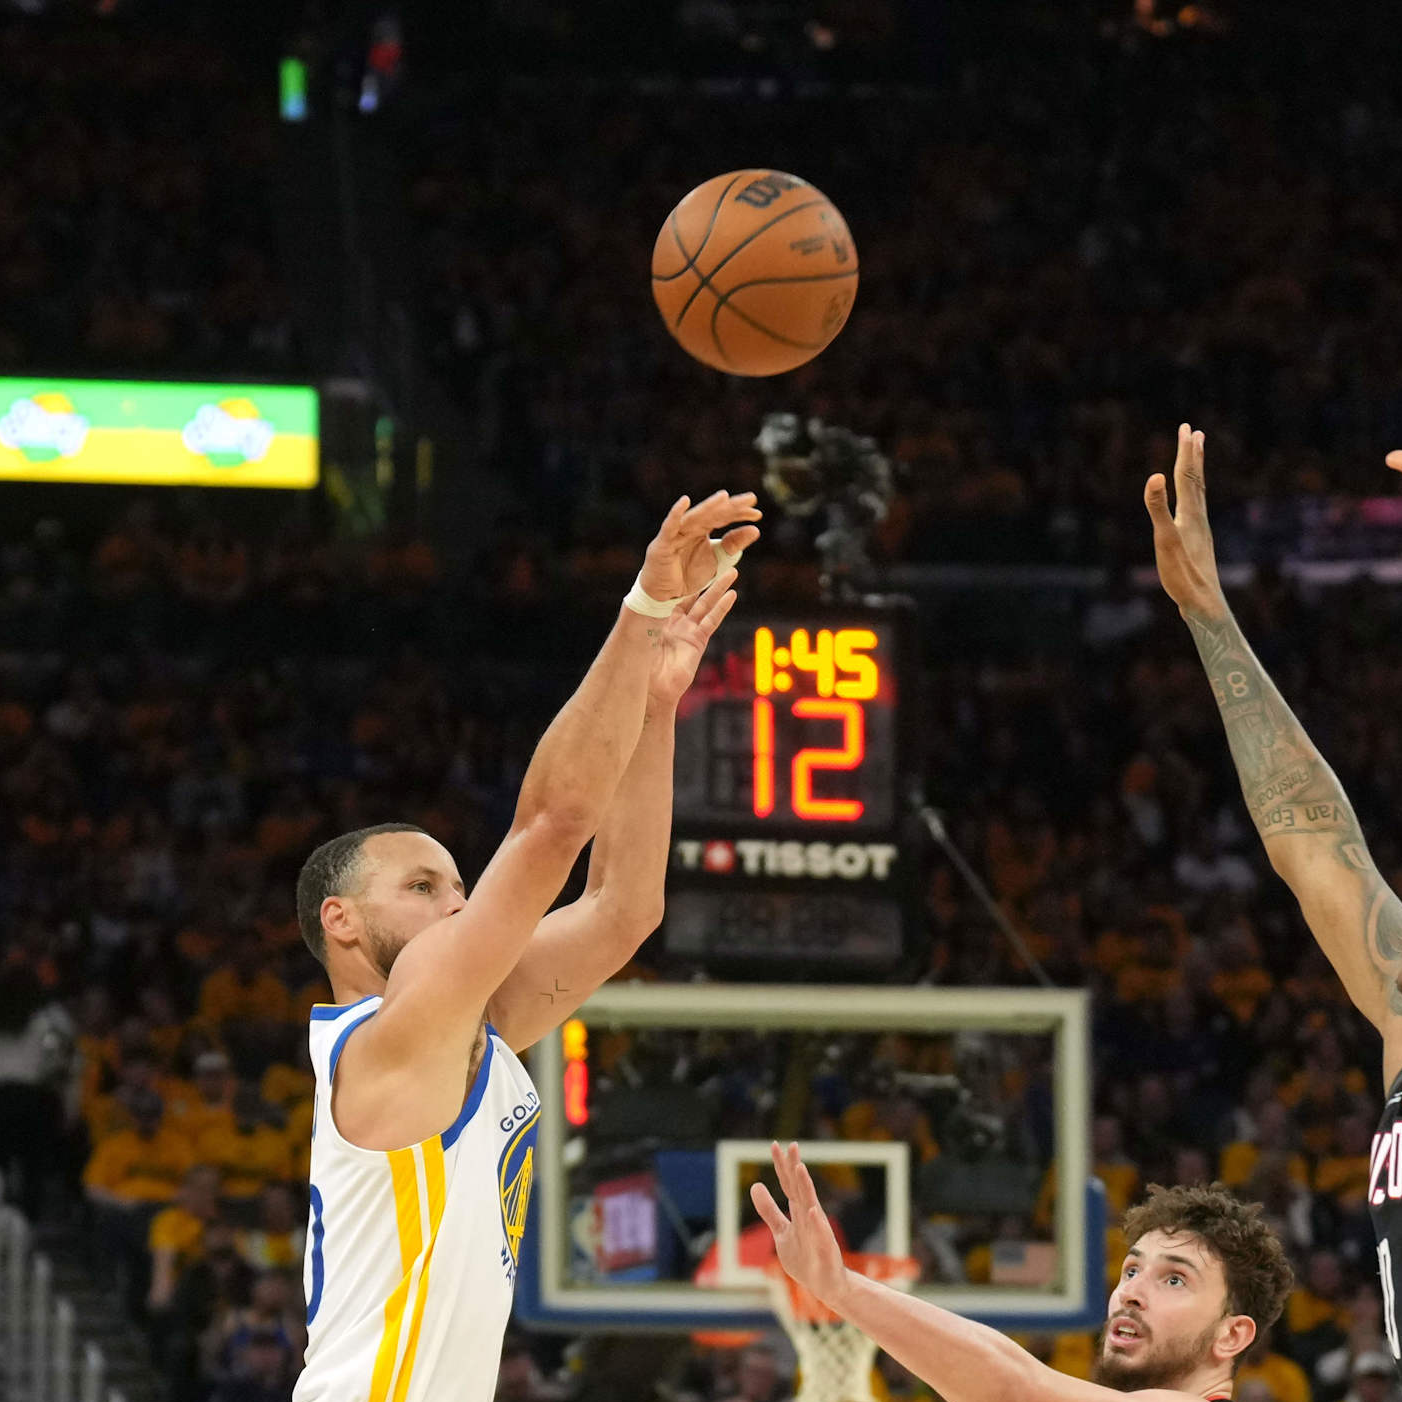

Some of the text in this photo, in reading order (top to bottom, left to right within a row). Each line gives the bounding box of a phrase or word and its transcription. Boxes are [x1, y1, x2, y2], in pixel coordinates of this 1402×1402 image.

[755, 627, 878, 700] 1:45
[753, 696, 865, 820] 12
[736, 842, 897, 878] TISSOT
